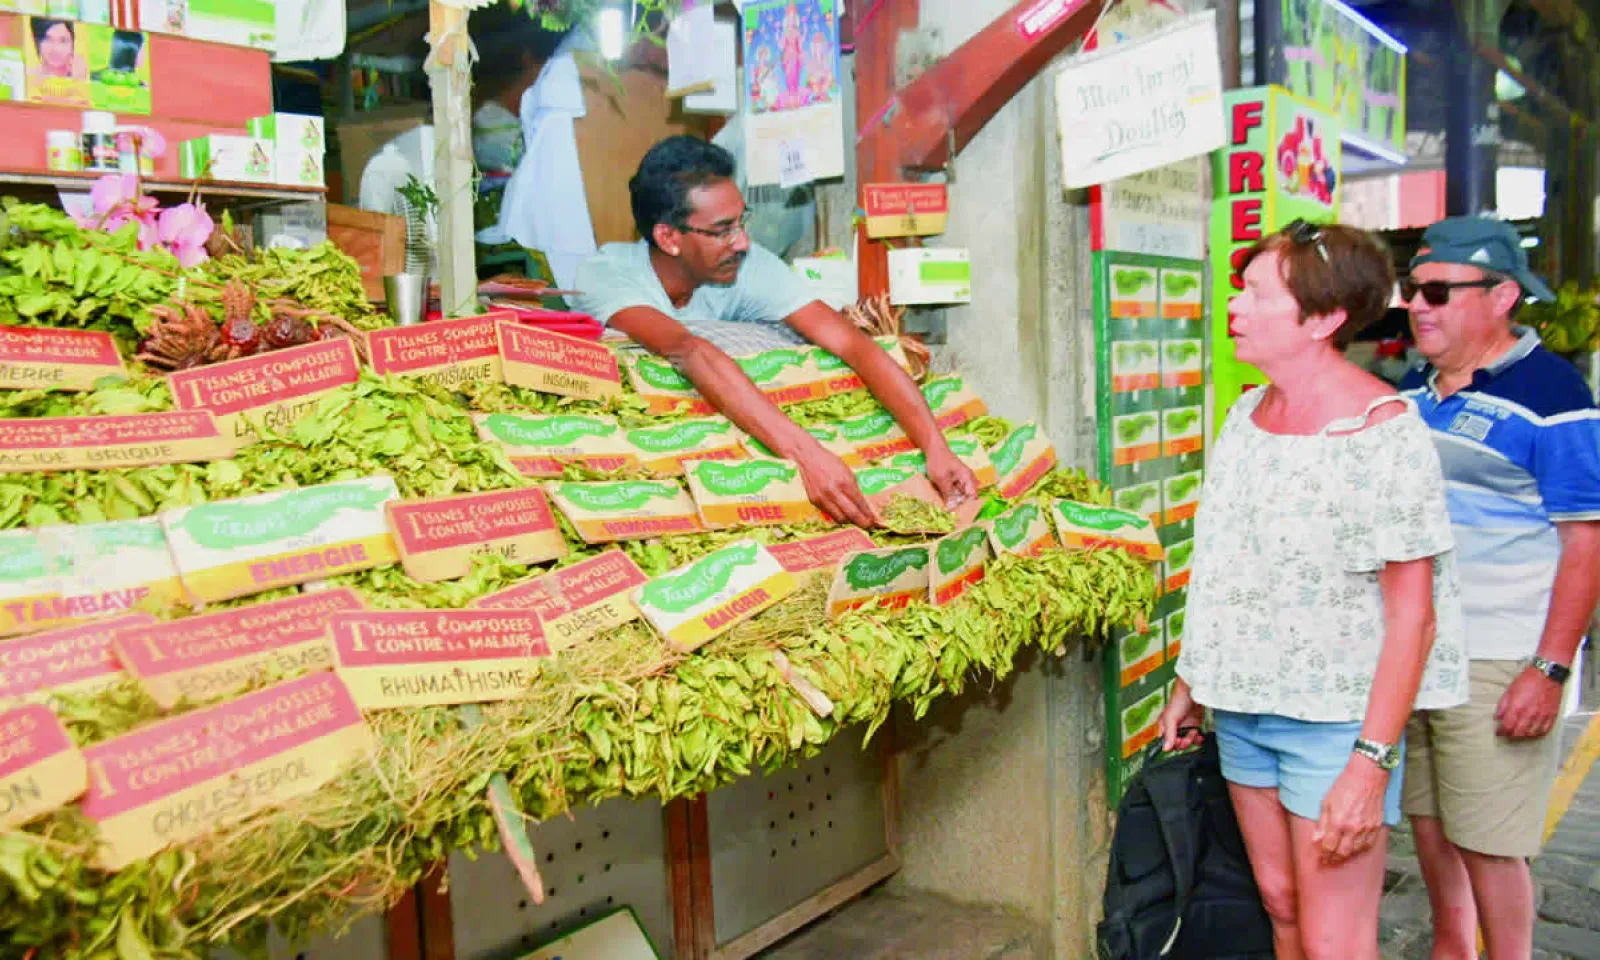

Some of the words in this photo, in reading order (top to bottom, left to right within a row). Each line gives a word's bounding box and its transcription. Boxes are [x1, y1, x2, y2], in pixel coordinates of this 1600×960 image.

[378, 333, 439, 363] TISANES
[443, 323, 495, 341] COMPOS
[400, 345, 448, 362] CONTRE
[181, 369, 256, 408] TISANES
[262, 348, 345, 376] COMPOSEES
[211, 382, 269, 405] CONTRE
[288, 364, 344, 386] MALADIE
[234, 419, 256, 437] LA
[86, 446, 172, 462] URIQUE
[404, 505, 465, 539] TISANES
[469, 494, 541, 517] COMPOSEES
[427, 520, 475, 539] CONTRE
[492, 511, 540, 527] MALADIE
[249, 543, 368, 583] ENERGIE
[340, 619, 429, 651] TISANES
[437, 614, 534, 634] COMPOSEES
[376, 637, 445, 654] CONTRE
[447, 640, 465, 650] LA
[468, 633, 531, 650] MALADIE
[379, 669, 527, 697] RHUMATHISME
